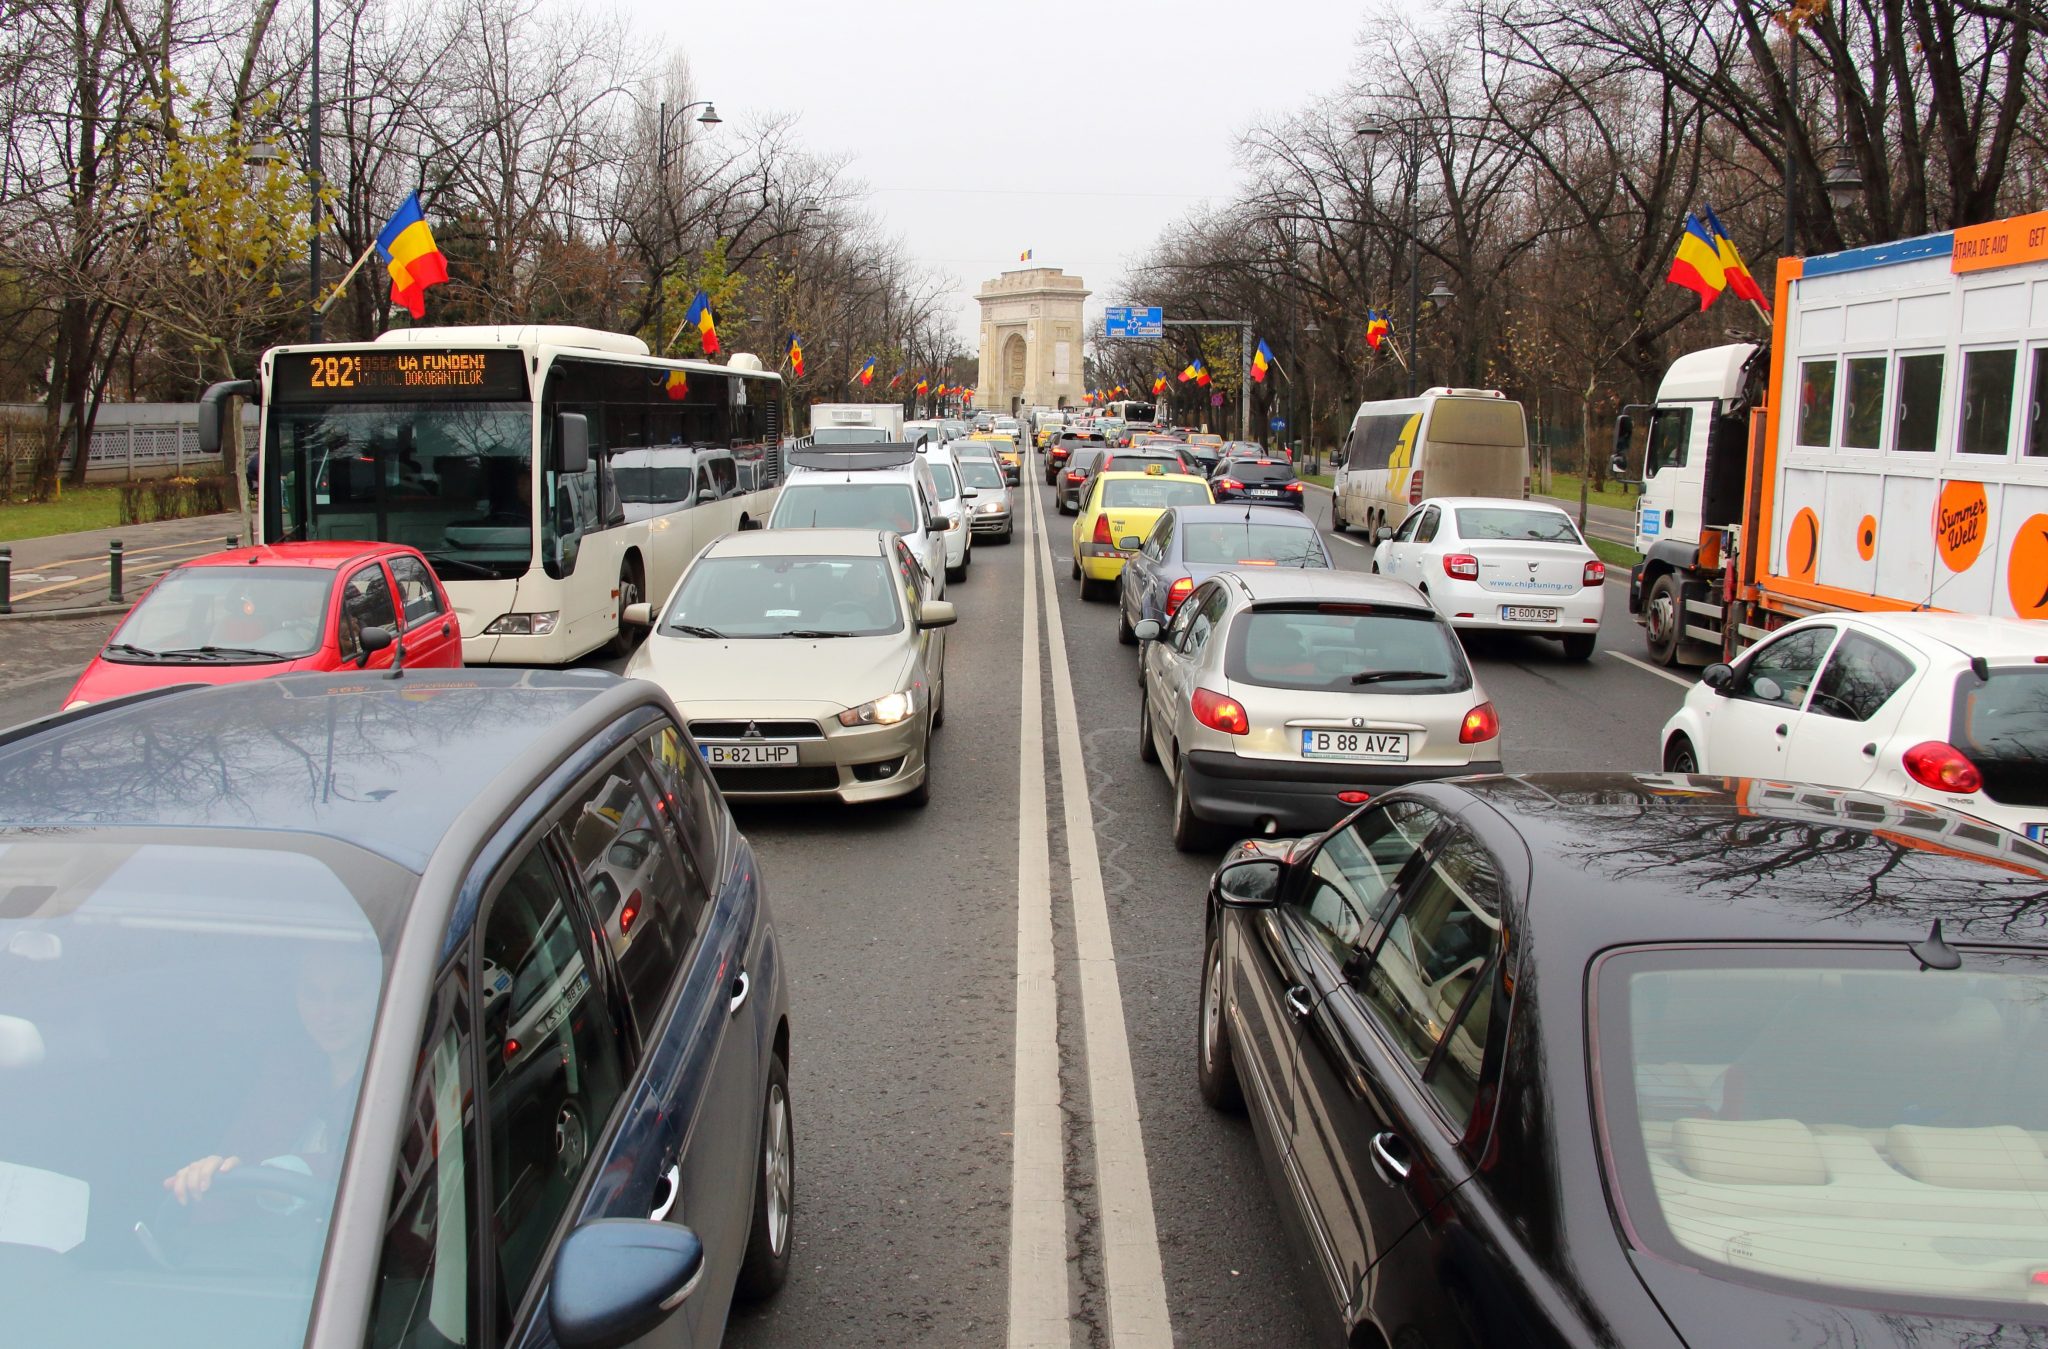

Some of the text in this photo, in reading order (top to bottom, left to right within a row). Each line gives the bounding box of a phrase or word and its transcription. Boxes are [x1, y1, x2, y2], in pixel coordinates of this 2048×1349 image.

[1979, 237, 1990, 256] DE
[1991, 234, 2009, 254] AICI
[2028, 226, 2047, 248] GET
[310, 356, 354, 387] 282
[423, 354, 486, 370] FUNDENI
[405, 370, 484, 386] DOROBANTILOR
[1939, 498, 1987, 535] Summer
[1948, 517, 1978, 552] Well
[1489, 580, 1573, 591] www.chiptuning.ro
[1509, 607, 1555, 619] B 600 ASP
[1317, 733, 1401, 753] B 88 AVZ
[712, 747, 725, 762] B
[731, 747, 751, 762] 82
[755, 746, 789, 762] LHP
